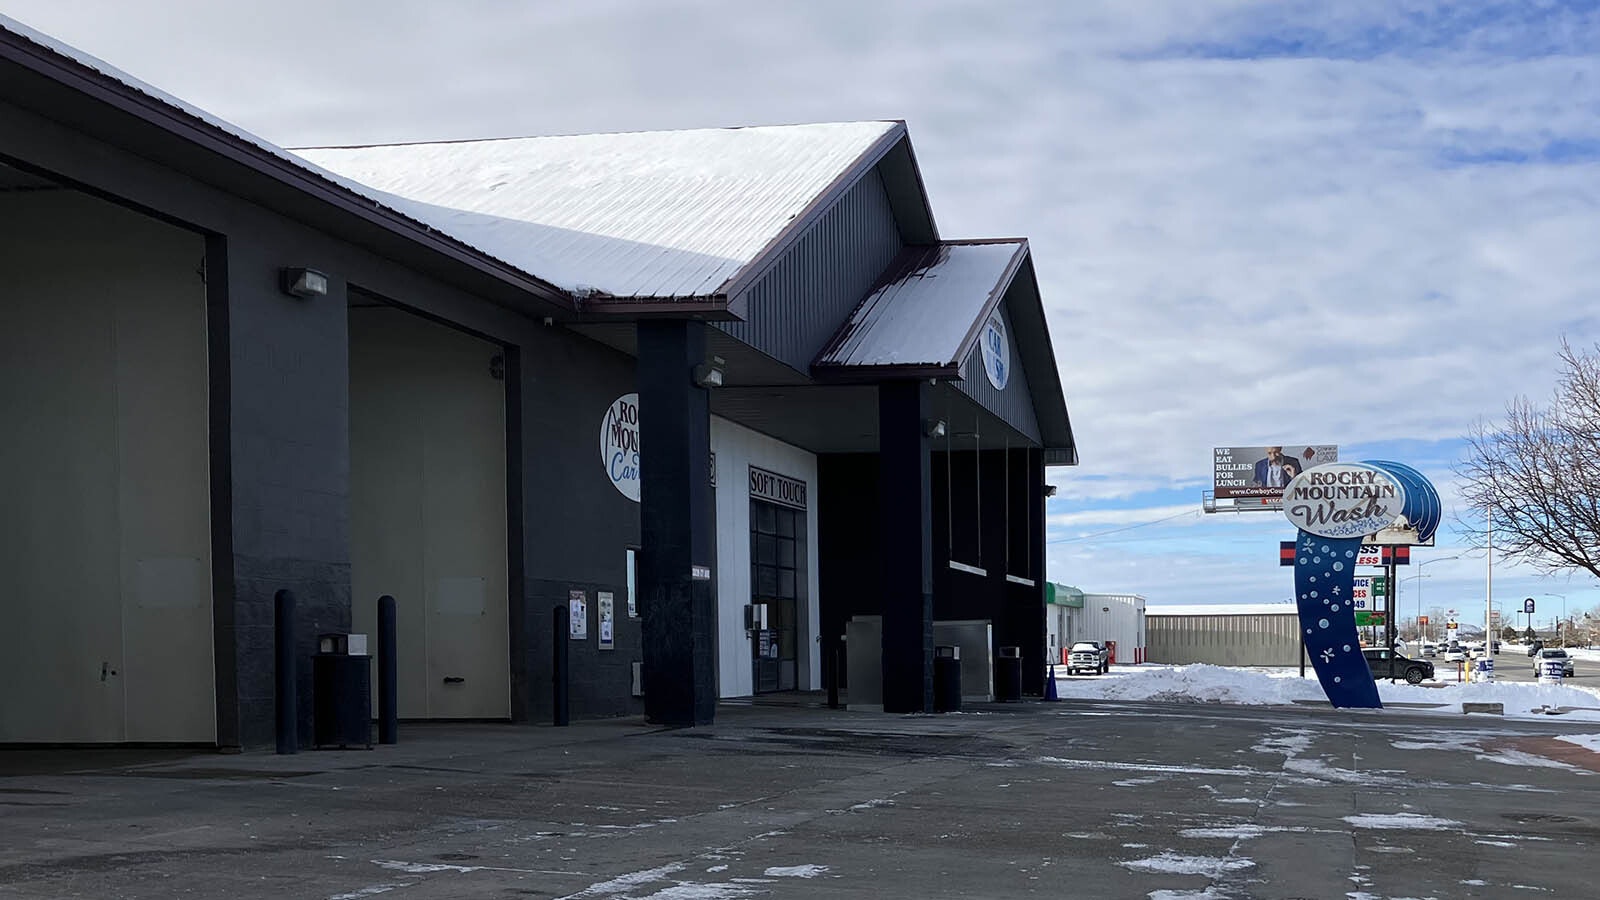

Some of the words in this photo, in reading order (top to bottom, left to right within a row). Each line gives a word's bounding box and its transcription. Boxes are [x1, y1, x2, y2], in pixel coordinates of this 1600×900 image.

[619, 400, 639, 426] RO
[611, 423, 640, 453] MOU
[611, 452, 637, 481] Car
[1216, 463, 1253, 471] BULLIES
[1216, 471, 1234, 479] FOR
[1310, 471, 1378, 486] ROCKY
[751, 470, 775, 497] SOFT
[777, 479, 806, 505] TOUCH
[1216, 479, 1246, 487] LUNCH
[1294, 485, 1394, 500] MOUNTAIN
[1291, 496, 1388, 527] Wash
[1360, 544, 1379, 554] SS
[1357, 557, 1379, 565] ESS
[1354, 579, 1369, 588] VICE
[1353, 589, 1367, 598] CES
[1354, 601, 1365, 609] 49
